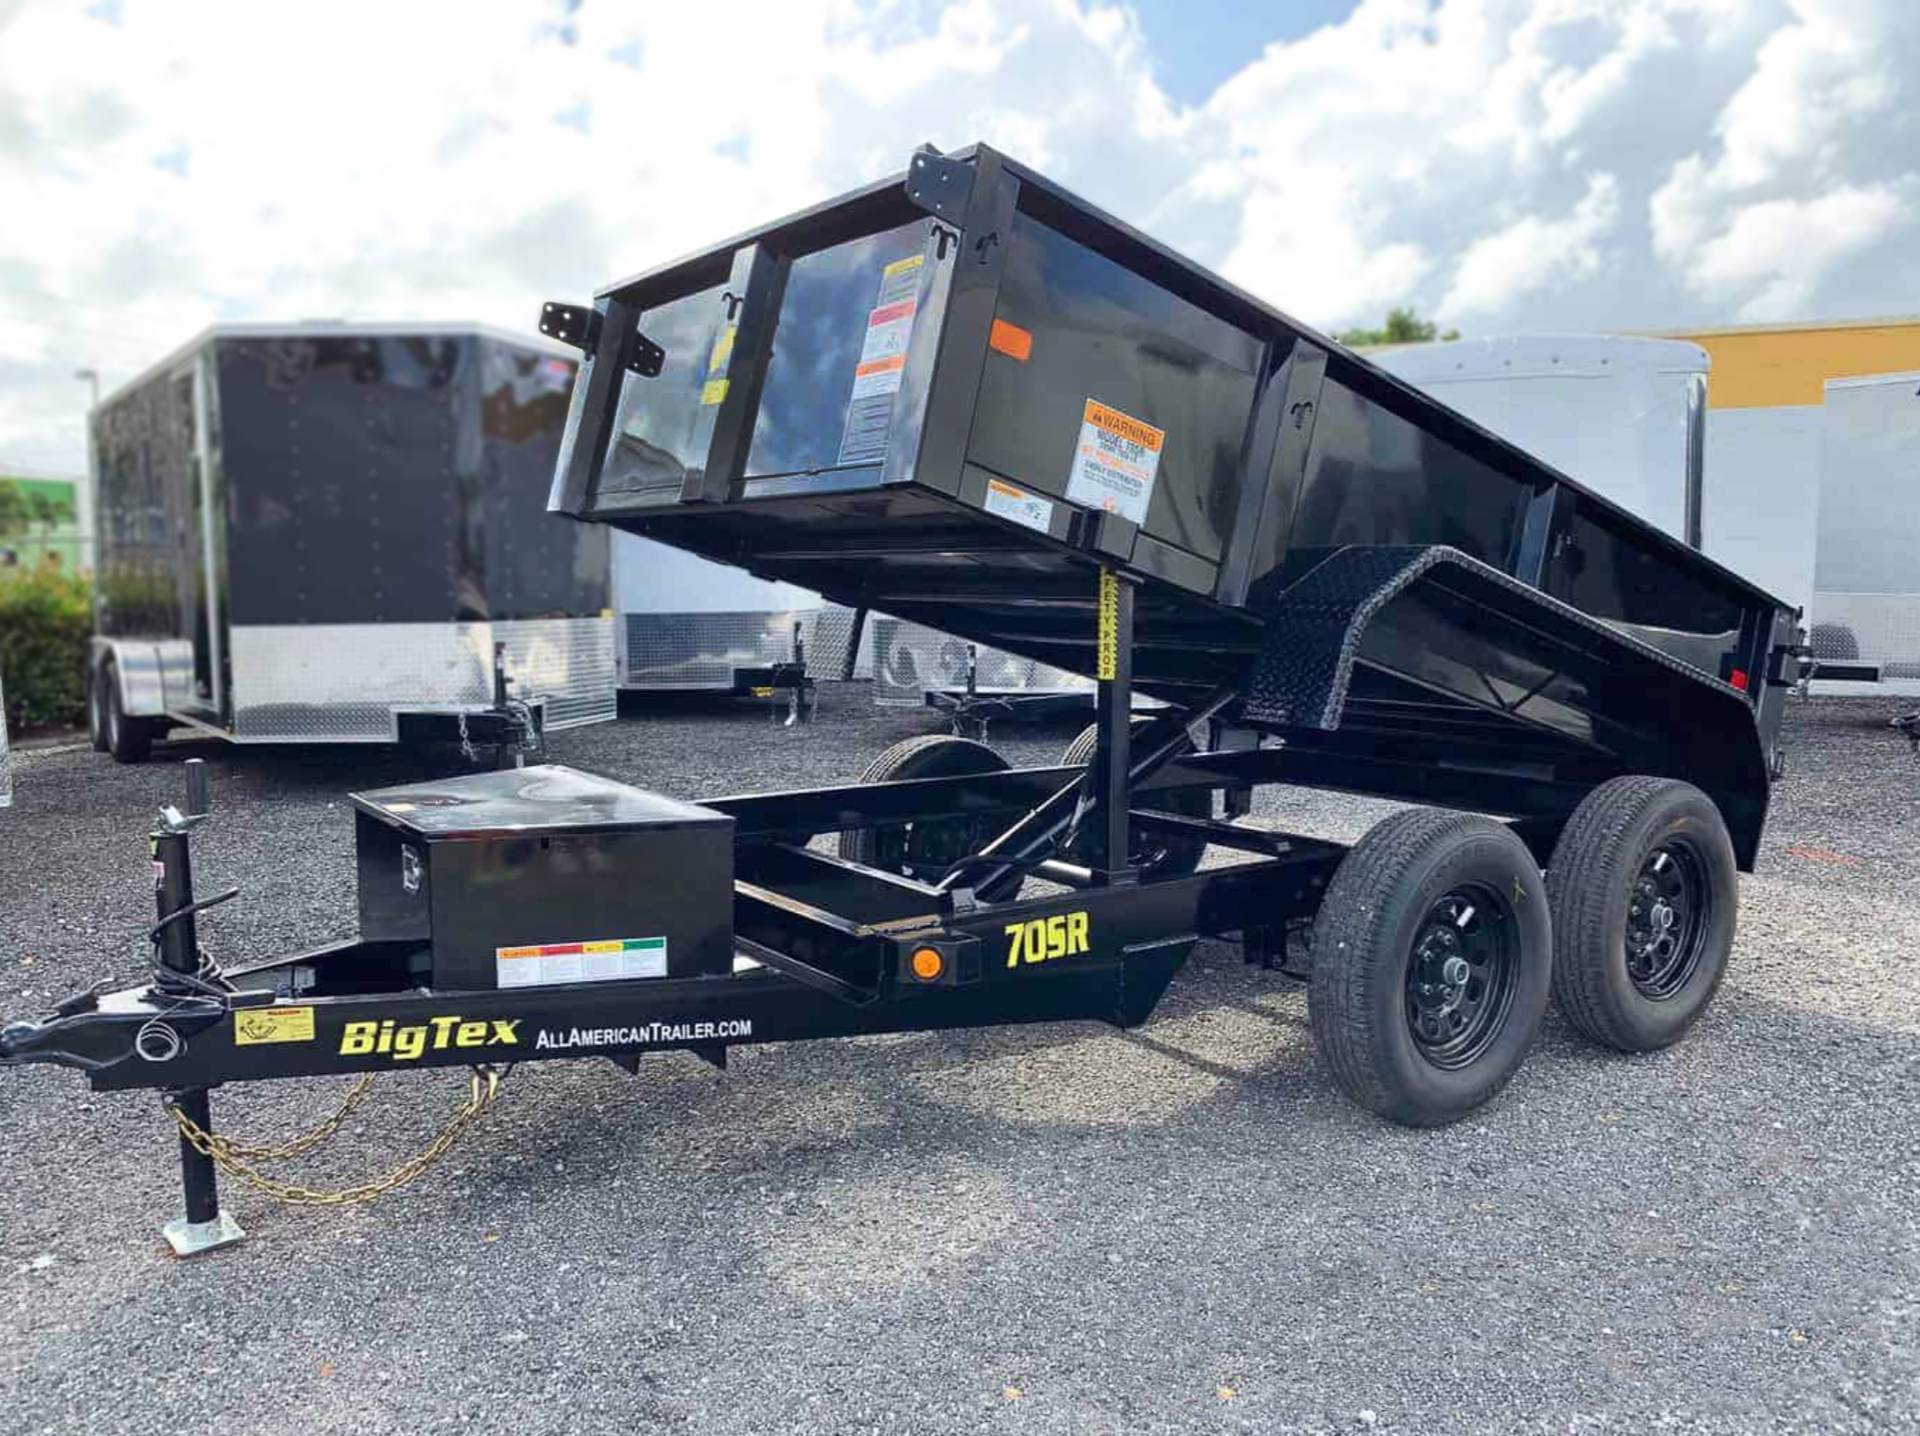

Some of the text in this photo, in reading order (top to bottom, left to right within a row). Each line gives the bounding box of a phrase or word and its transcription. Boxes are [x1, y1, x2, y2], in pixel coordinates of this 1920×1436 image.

[1103, 413, 1156, 446] WARNING
[1102, 630, 1112, 677] PROP
[339, 1016, 522, 1060] BigTex
